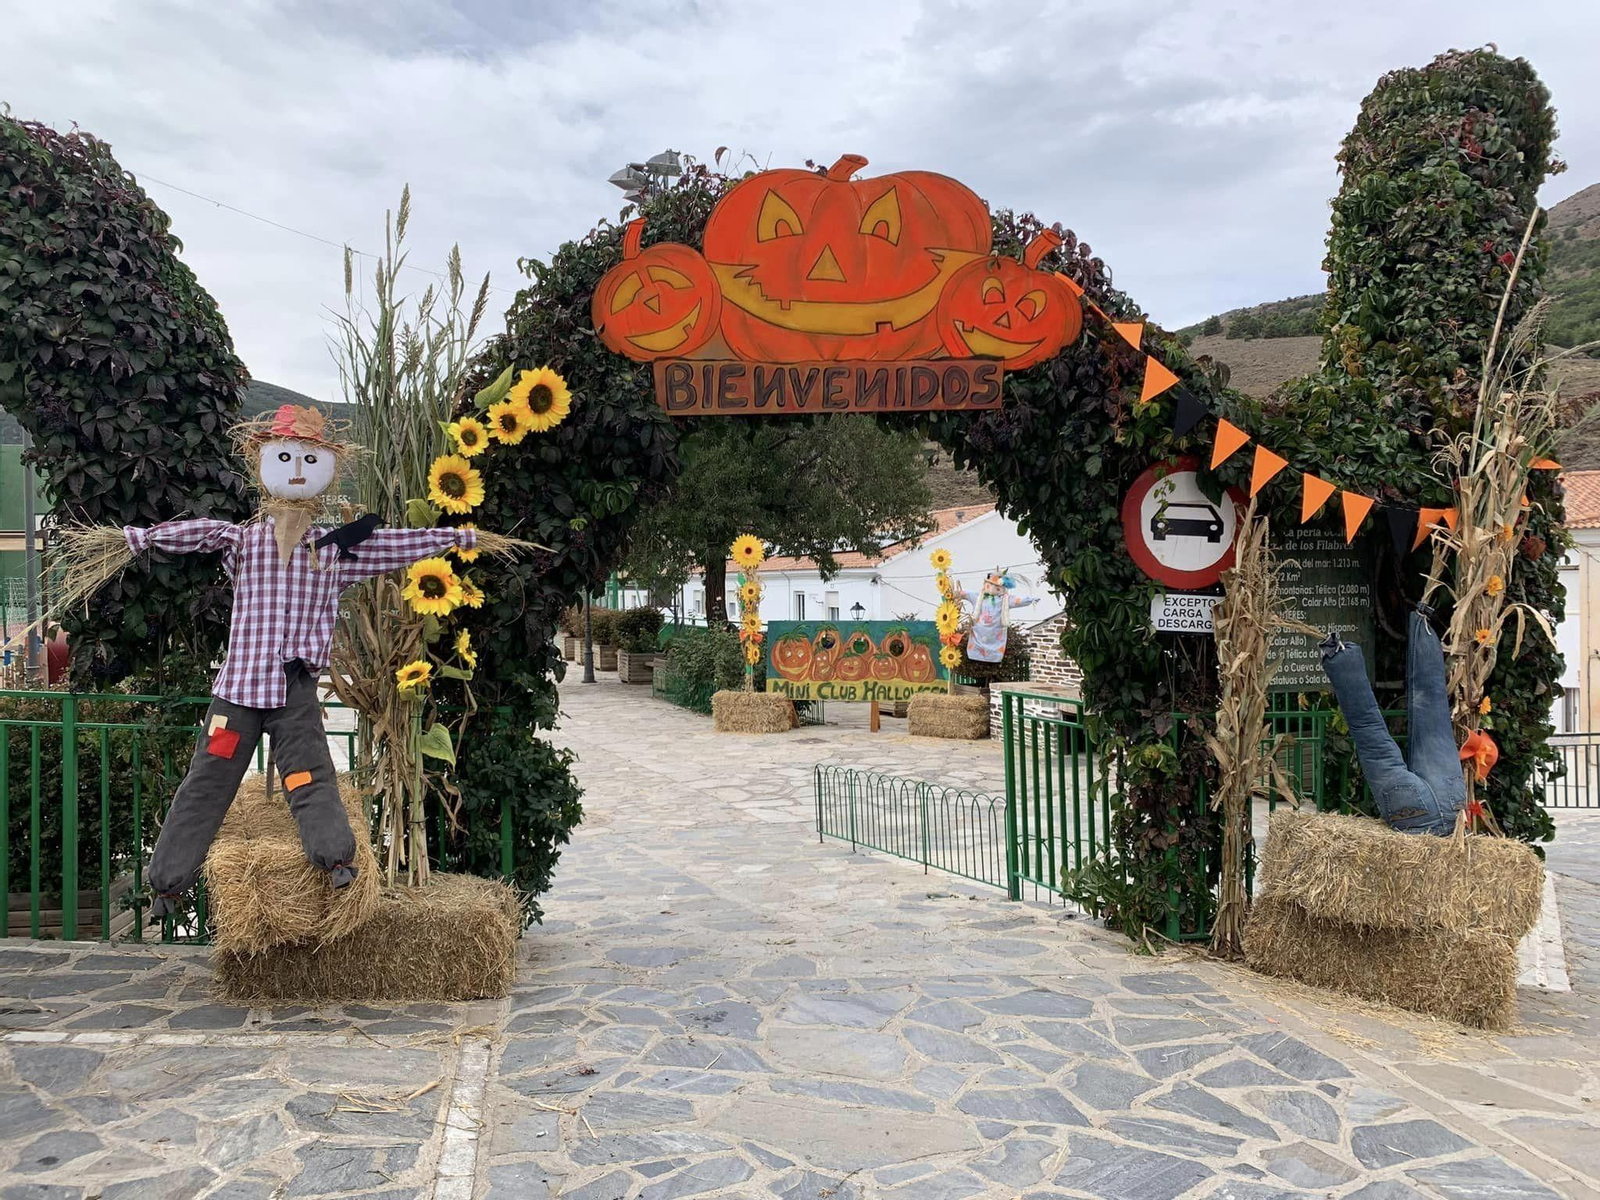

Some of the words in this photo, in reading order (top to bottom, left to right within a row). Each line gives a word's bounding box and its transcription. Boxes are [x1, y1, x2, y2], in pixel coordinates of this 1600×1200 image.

[665, 363, 1000, 409] BIENVENIDOS
[1296, 528, 1321, 539] perla
[1285, 540, 1298, 550] de
[1300, 540, 1314, 550] los
[1302, 559, 1314, 568] del
[1315, 560, 1331, 568] mar:
[1333, 558, 1351, 568] 1.213
[1360, 584, 1370, 595] m)
[1164, 598, 1217, 607] EXCEPTO
[1302, 597, 1321, 607] Calar
[1323, 597, 1337, 607] Alto
[1338, 597, 1359, 608] (2.168
[1360, 597, 1370, 608] m)
[1163, 608, 1203, 618] CARGA
[1158, 619, 1214, 630] DESCARG
[1290, 636, 1307, 646] Alto)
[1267, 650, 1276, 659] de
[1309, 648, 1319, 658] de
[1290, 663, 1313, 672] Cueva
[1305, 675, 1321, 684] Sala
[816, 682, 856, 700] CLUB
